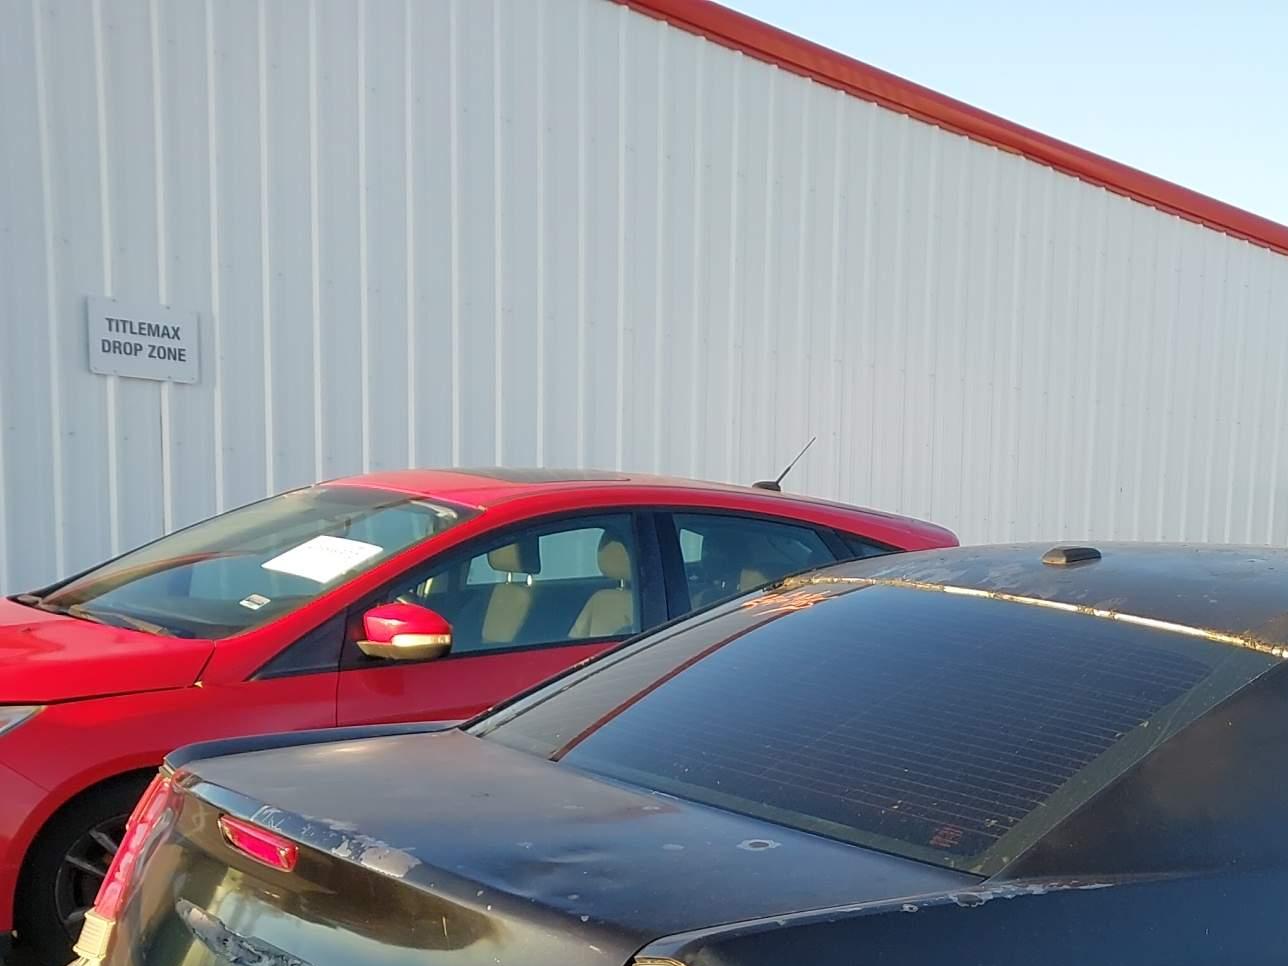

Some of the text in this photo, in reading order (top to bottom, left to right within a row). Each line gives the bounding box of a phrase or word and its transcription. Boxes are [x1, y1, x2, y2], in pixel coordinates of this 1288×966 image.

[104, 317, 181, 340] TITLEMAX
[101, 338, 187, 362] DROP ZONE
